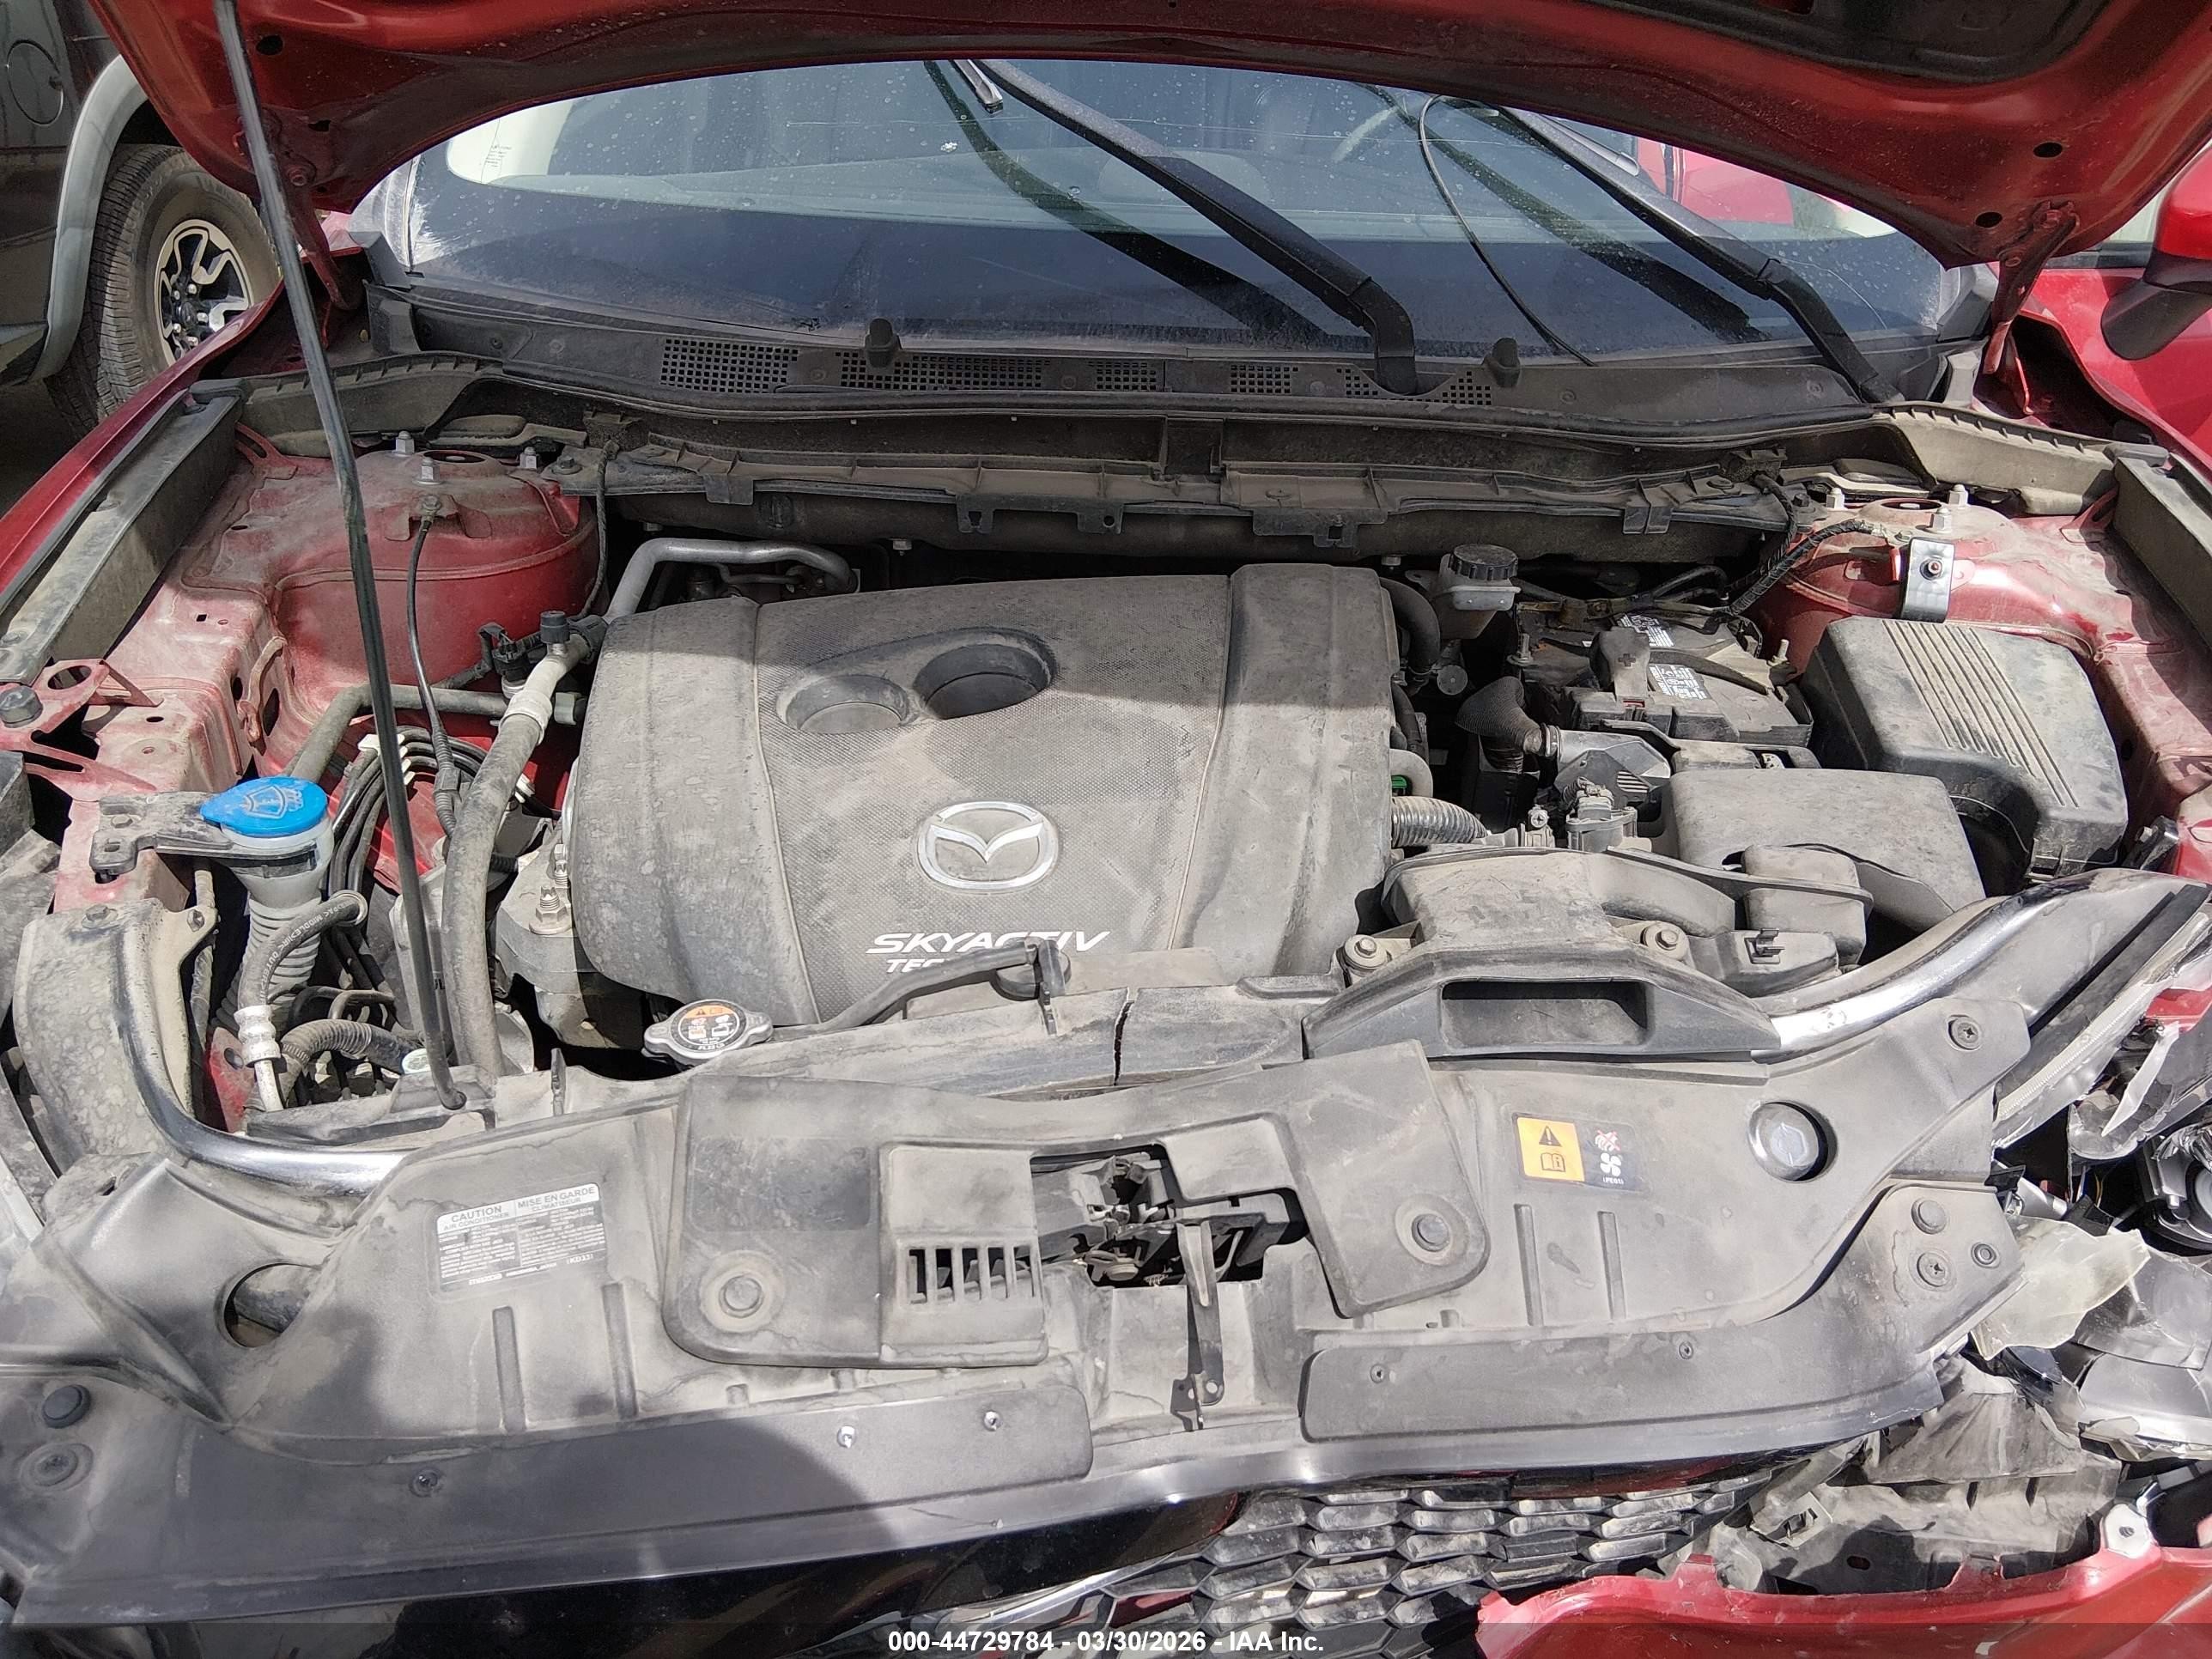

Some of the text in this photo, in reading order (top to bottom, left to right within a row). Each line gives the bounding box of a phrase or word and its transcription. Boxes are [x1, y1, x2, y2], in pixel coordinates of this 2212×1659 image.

[518, 1186, 595, 1209] MISE EN GARDE
[452, 1206, 501, 1222] CAUTION
[459, 1212, 509, 1228] CONDITIONER
